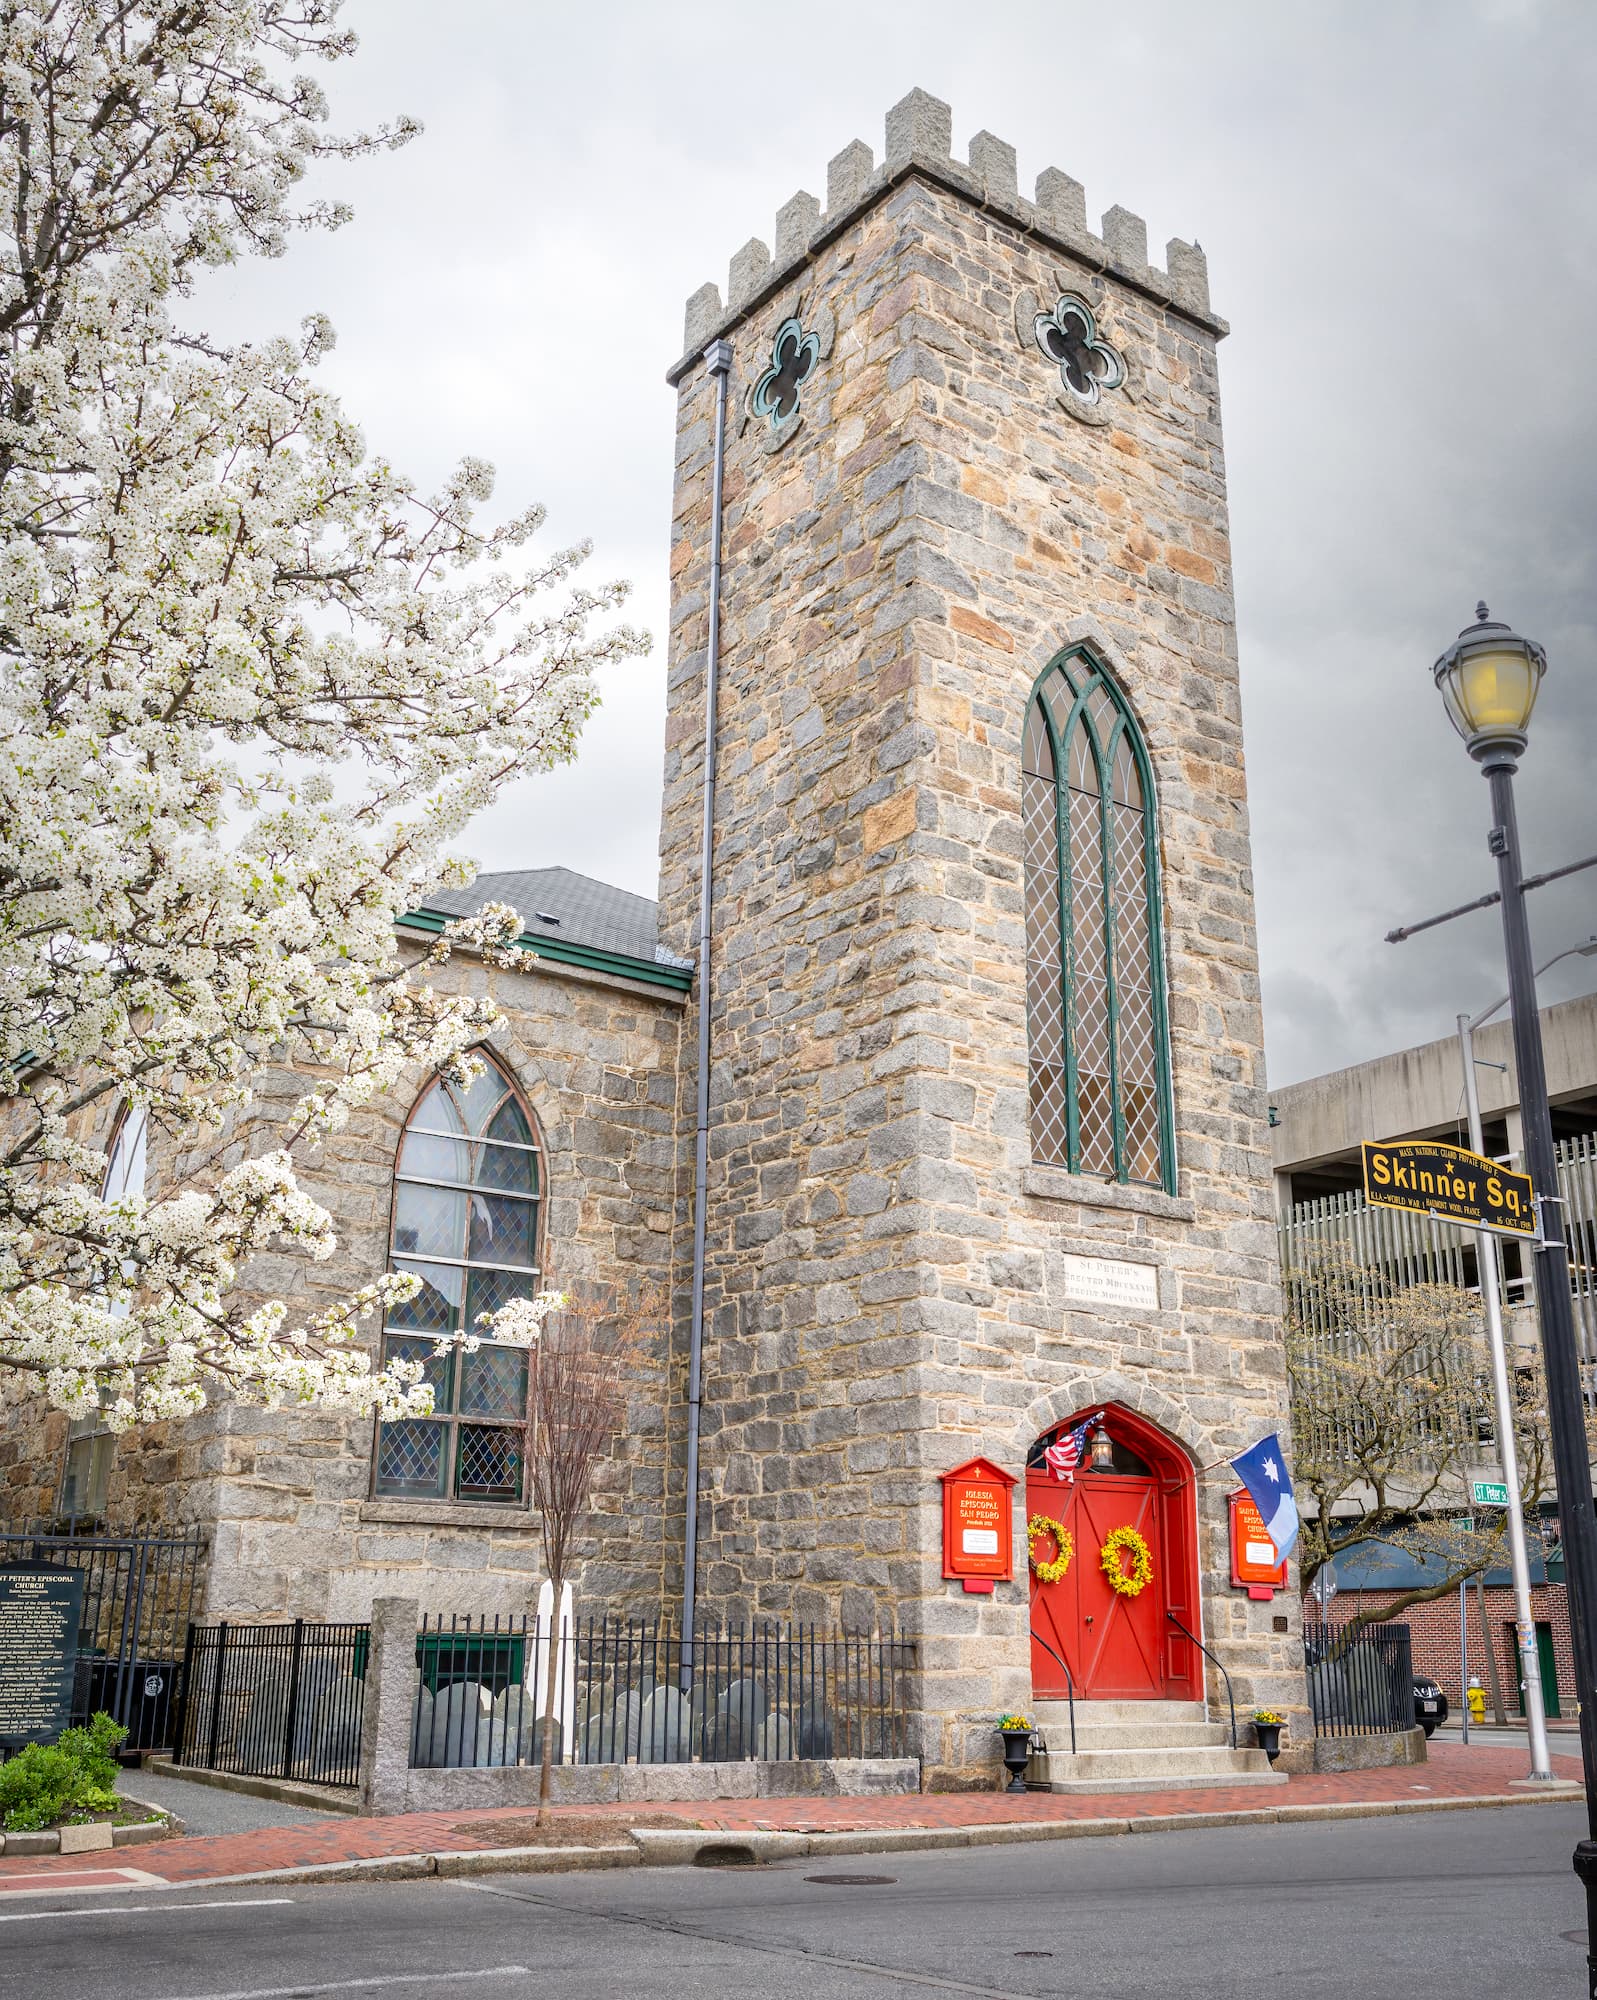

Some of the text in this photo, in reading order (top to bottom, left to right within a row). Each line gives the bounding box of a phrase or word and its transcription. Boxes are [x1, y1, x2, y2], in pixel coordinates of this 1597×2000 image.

[1416, 1147, 1439, 1157] NATIONAL
[1441, 1149, 1457, 1160] GUARD
[1458, 1153, 1478, 1167] PRIVATE
[1480, 1160, 1492, 1174] FRED
[1372, 1153, 1528, 1217] Skinner Sq.
[1464, 1205, 1481, 1217] FRANCE
[1506, 1218, 1517, 1227] OCT
[966, 1491, 993, 1499] IGLESIA
[1487, 1486, 1500, 1500] Peter
[960, 1500, 998, 1509] EPISCOPAL
[960, 1510, 999, 1519] SAN PEDRO
